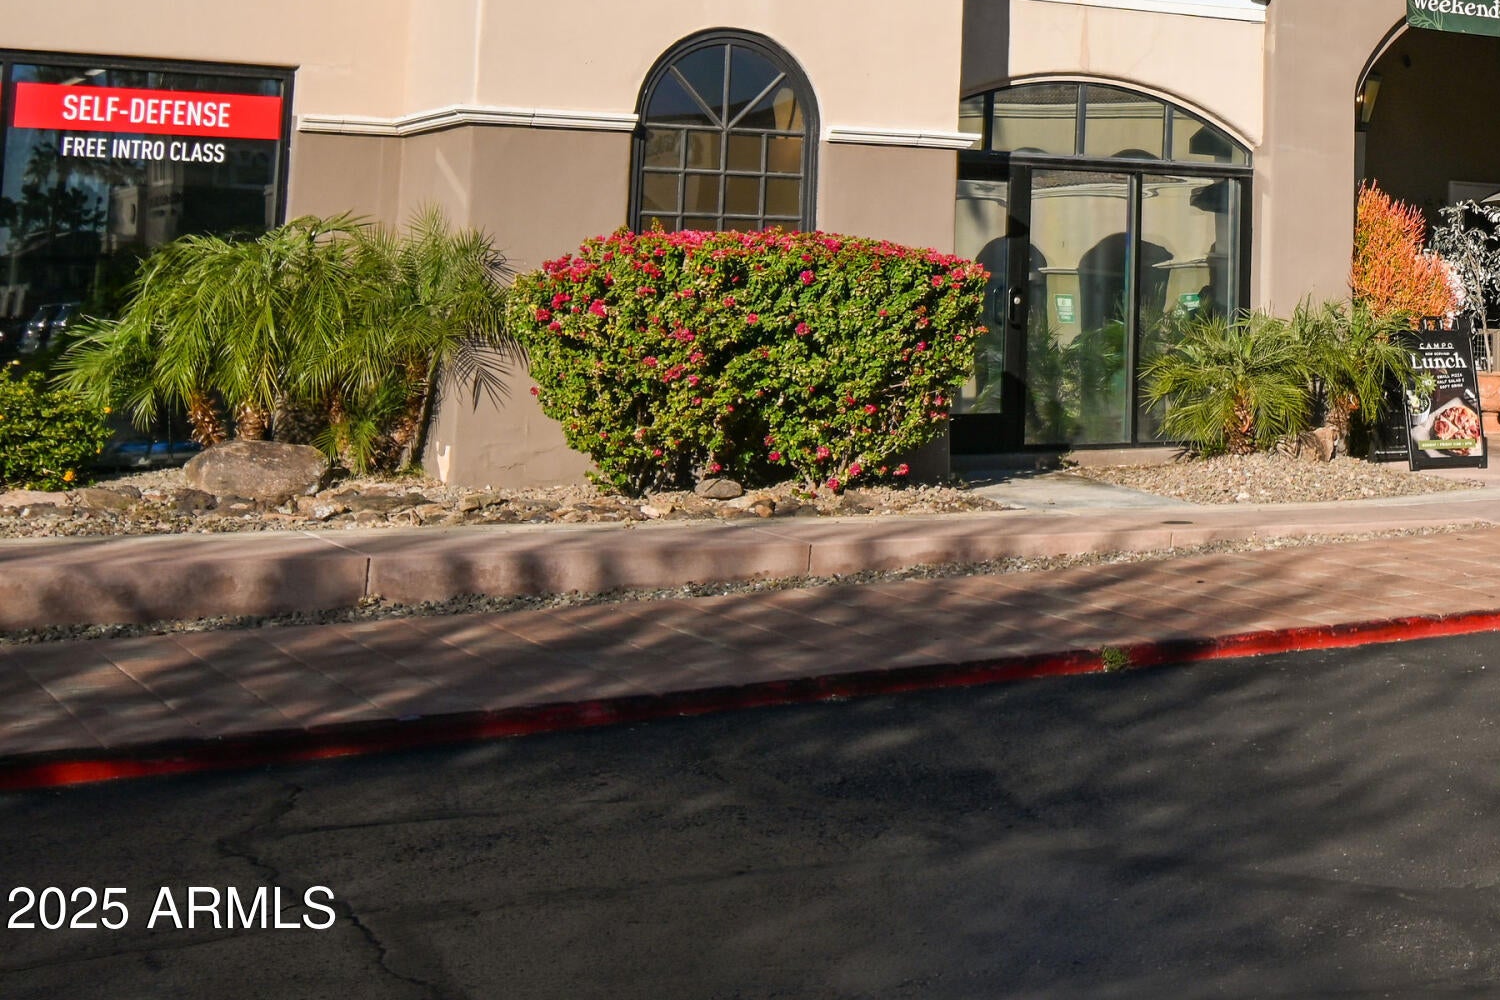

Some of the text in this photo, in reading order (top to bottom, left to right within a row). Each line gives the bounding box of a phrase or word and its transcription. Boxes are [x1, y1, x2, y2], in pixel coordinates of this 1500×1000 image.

[62, 94, 231, 128] SELF-DEFENSE
[62, 136, 225, 163] FREE INTRO CLASS
[1419, 342, 1454, 350] CAMPO
[1410, 352, 1468, 369] Lunch
